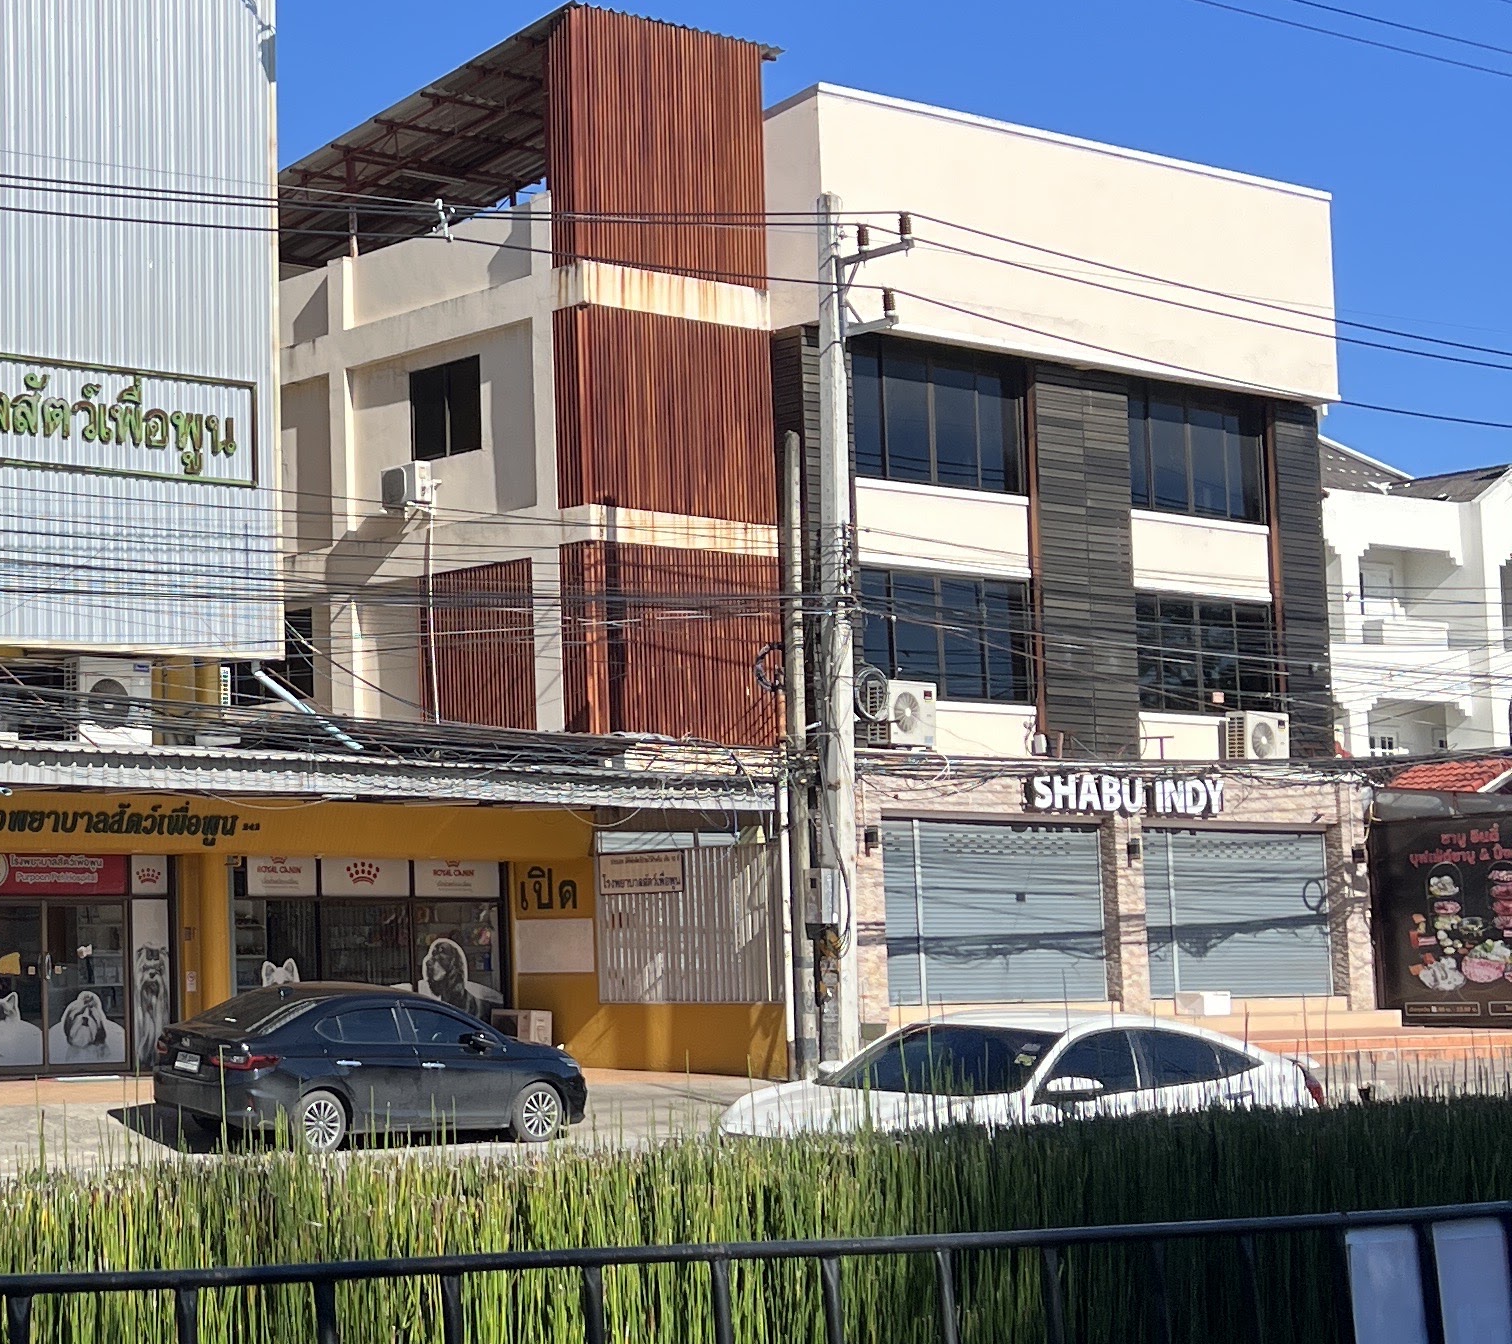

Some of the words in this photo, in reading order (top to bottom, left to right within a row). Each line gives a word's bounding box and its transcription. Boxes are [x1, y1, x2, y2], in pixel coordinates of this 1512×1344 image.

[1033, 774, 1143, 814] SHABU
[1154, 779, 1224, 814] INDY
[256, 865, 278, 874] ROYAL
[432, 868, 453, 877] ROYAL
[520, 865, 578, 911] เปิด
